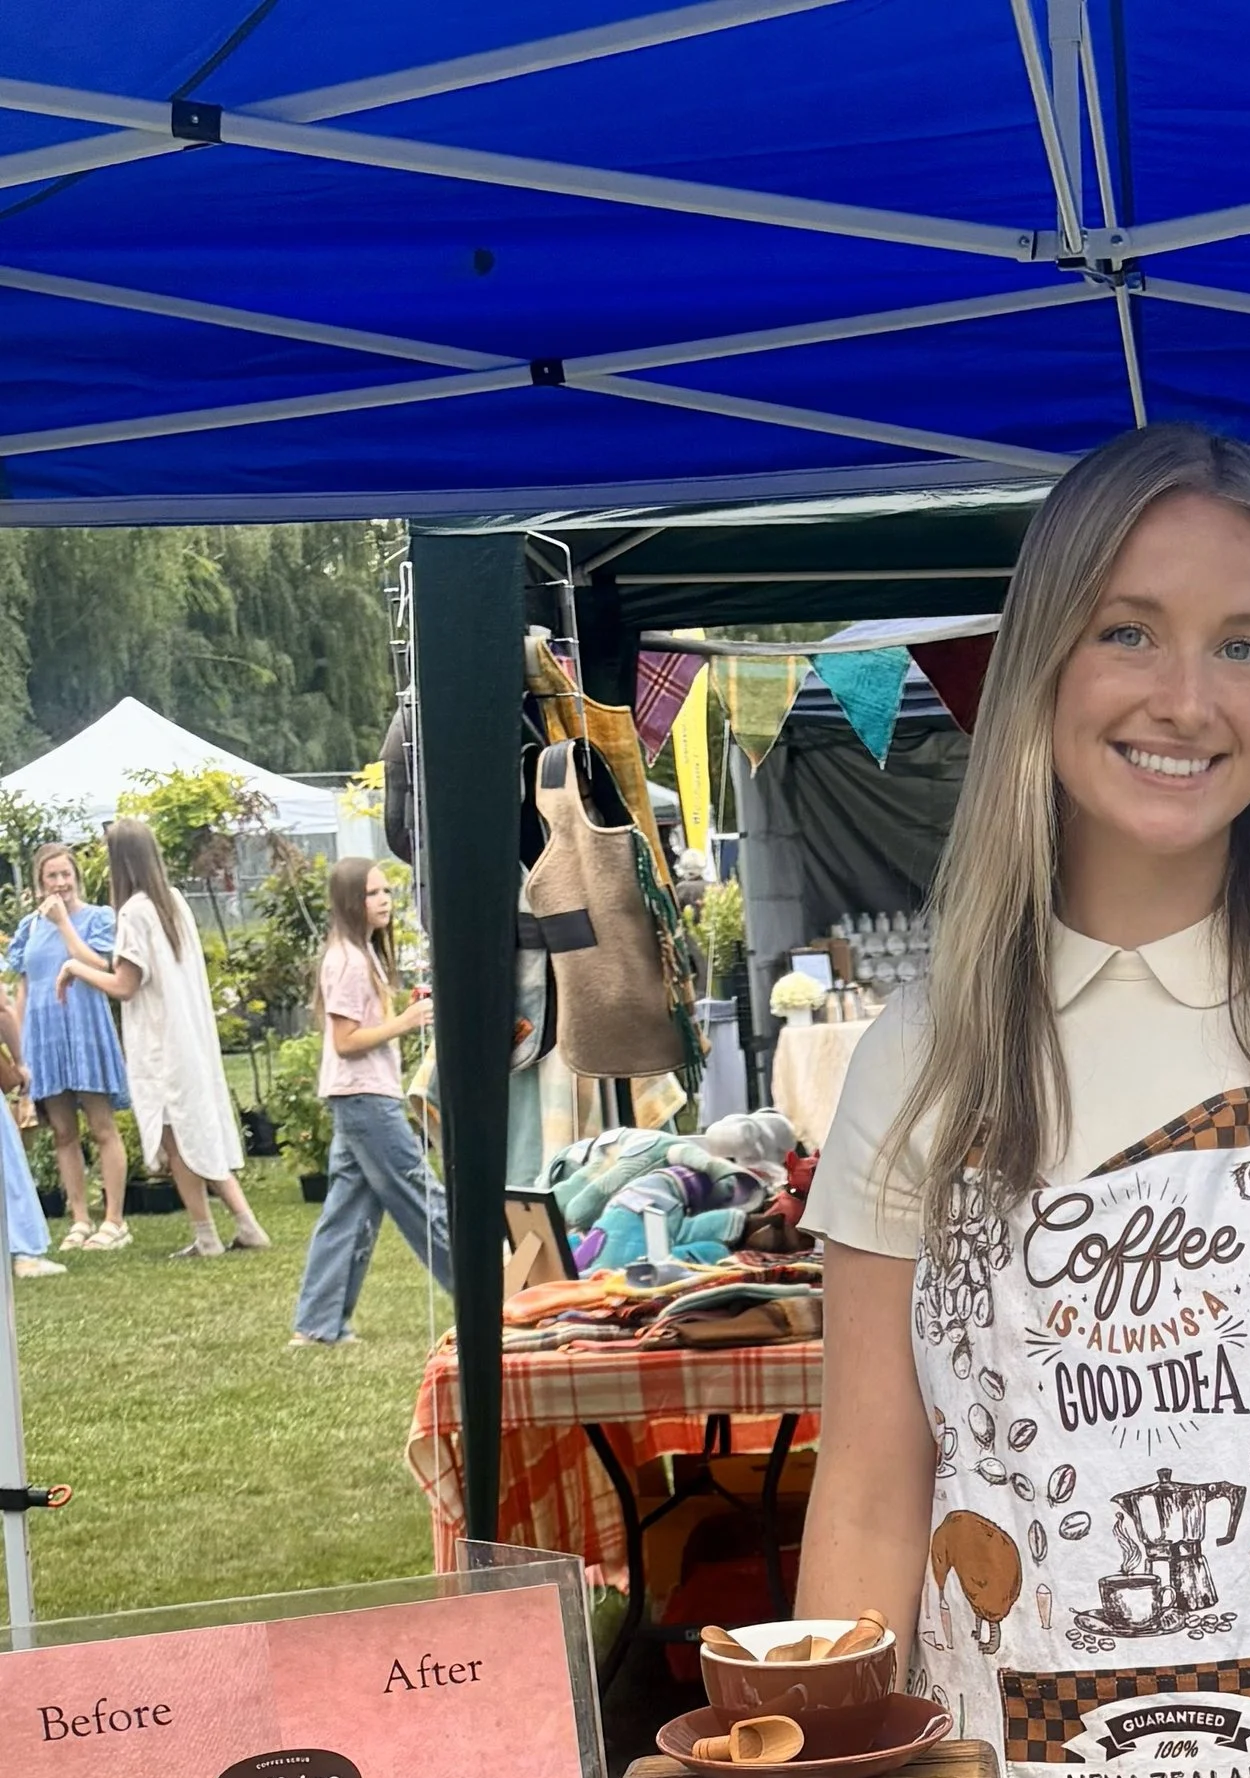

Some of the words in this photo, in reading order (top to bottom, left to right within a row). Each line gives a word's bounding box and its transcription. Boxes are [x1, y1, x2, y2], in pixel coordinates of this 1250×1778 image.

[1023, 1190, 1246, 1321] Coffee
[1054, 1361, 1143, 1432] GOOD
[1147, 1344, 1250, 1416] IDEA
[383, 1653, 483, 1694] After
[38, 1699, 173, 1742] Before
[1121, 1711, 1226, 1732] GUARANTEED
[1154, 1740, 1199, 1759] 100%
